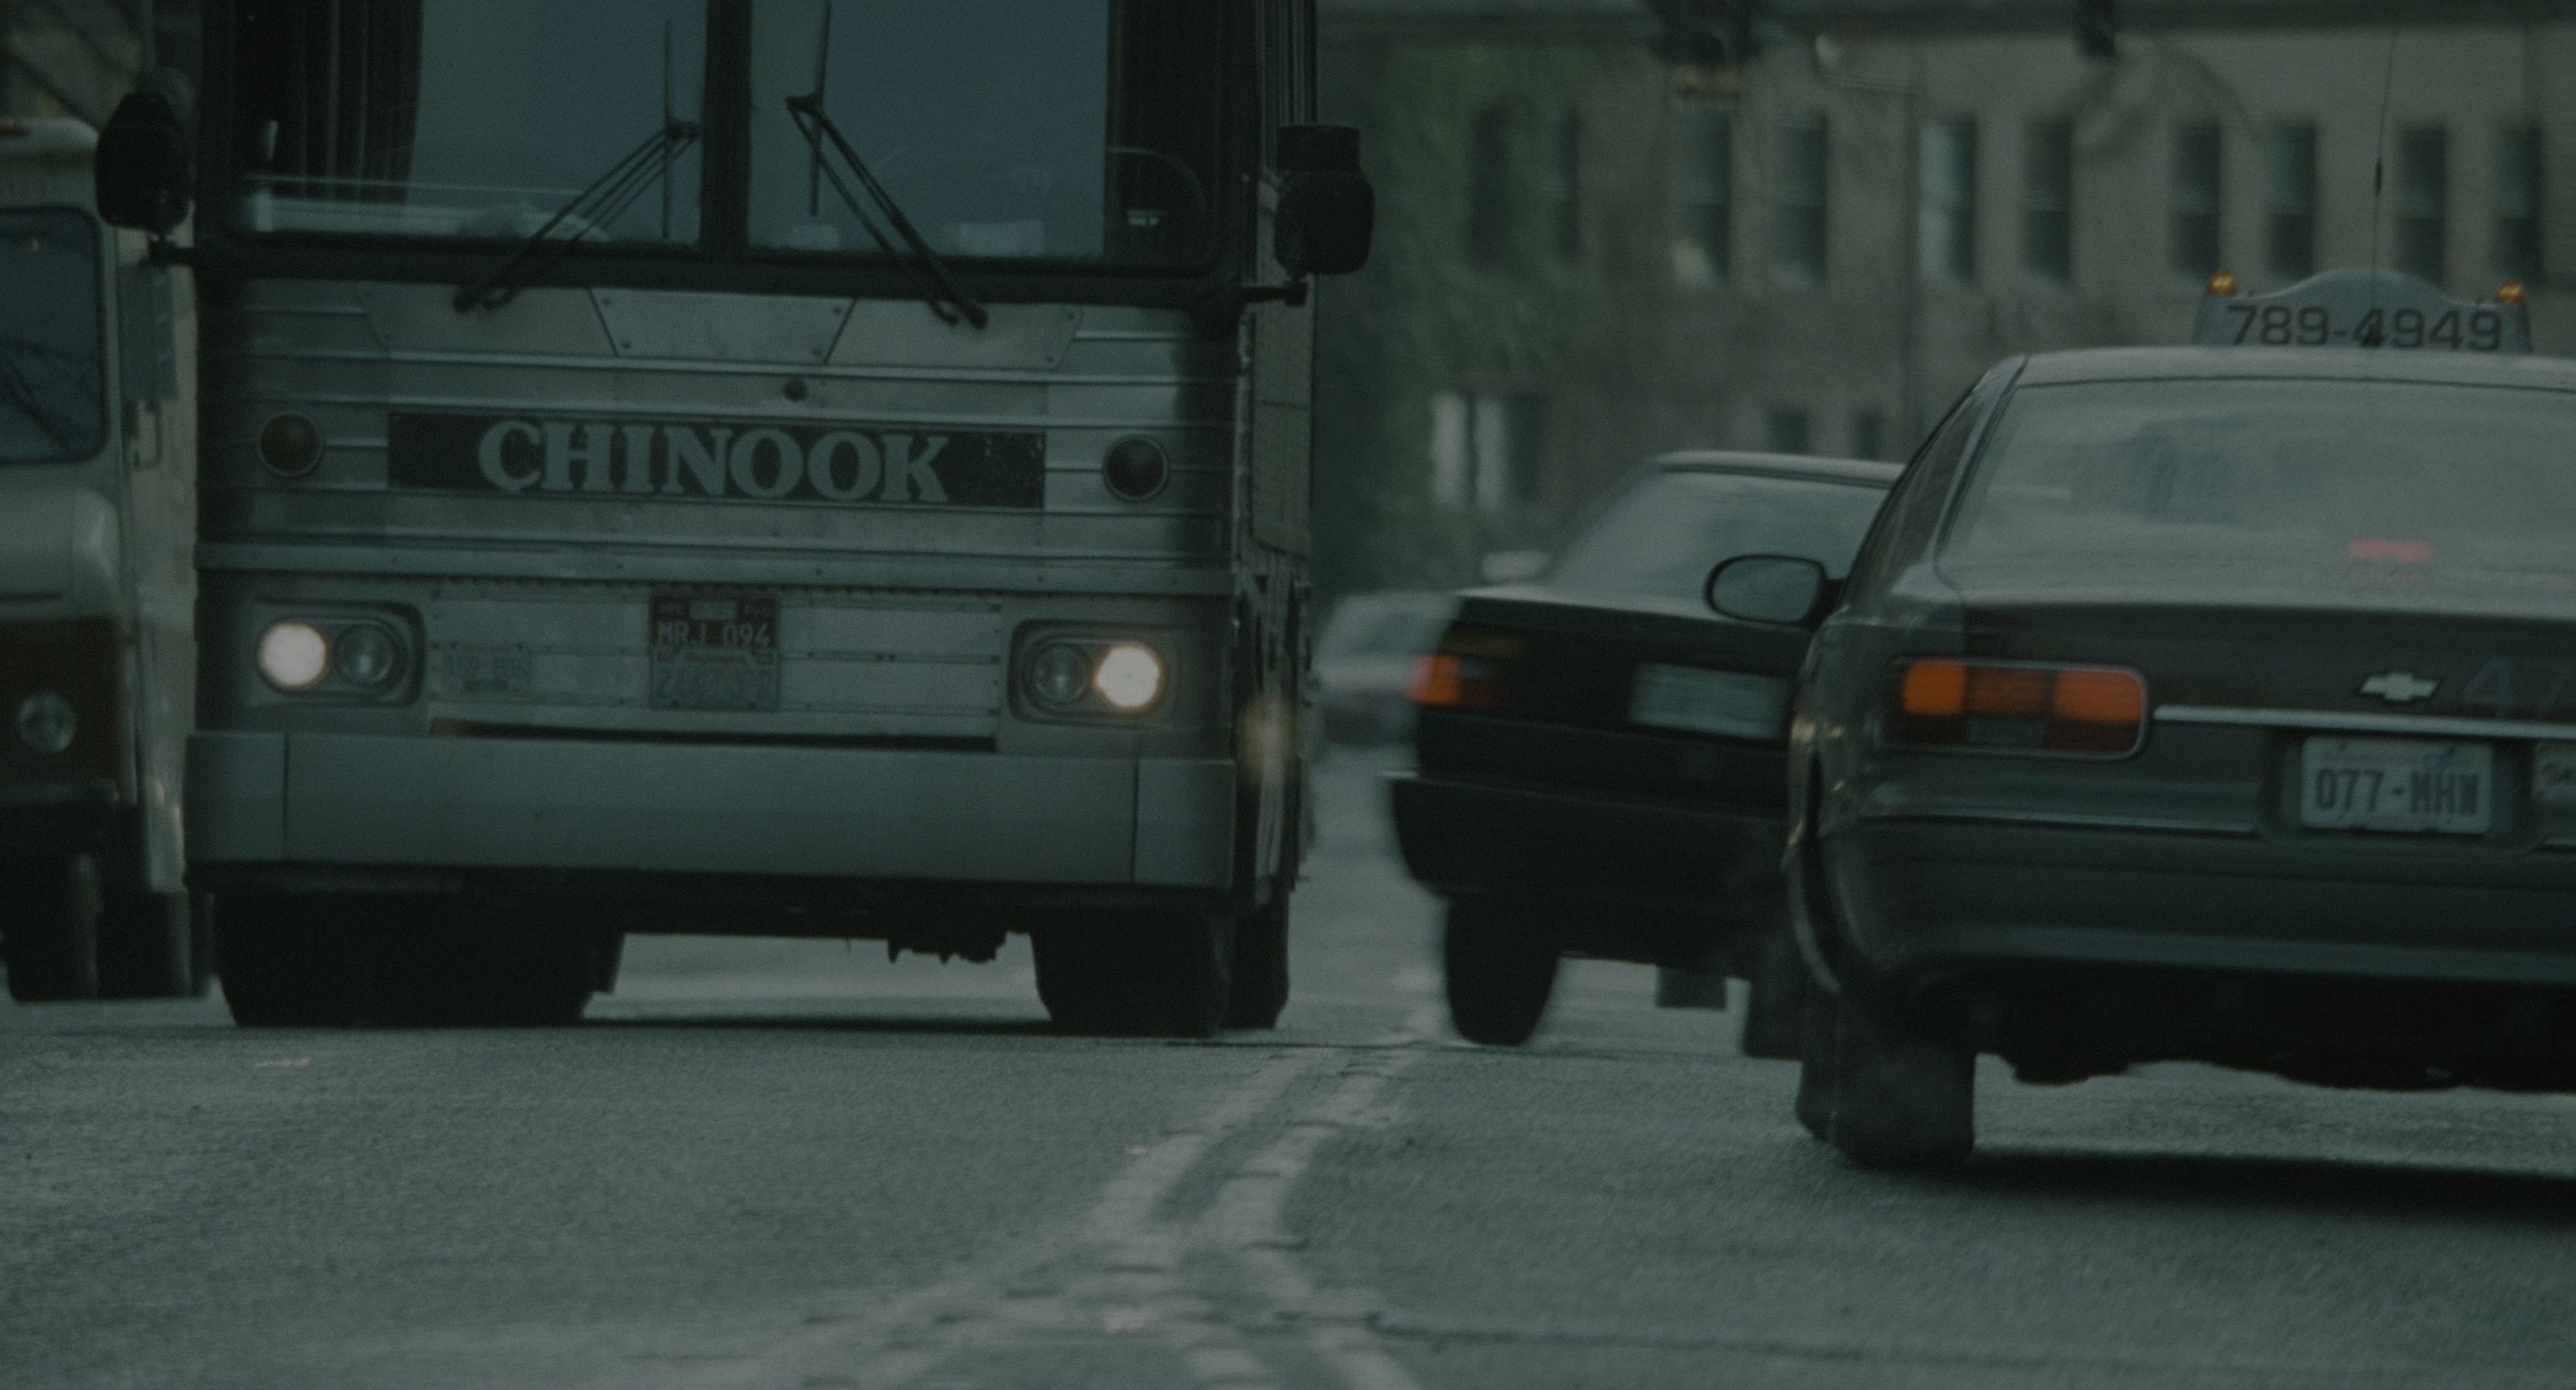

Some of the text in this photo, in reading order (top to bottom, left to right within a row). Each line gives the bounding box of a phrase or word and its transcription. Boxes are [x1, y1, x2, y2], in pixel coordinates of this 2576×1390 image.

[2227, 305, 2502, 352] 789-4949
[478, 420, 949, 503] CHINOOK
[721, 622, 771, 648] 094
